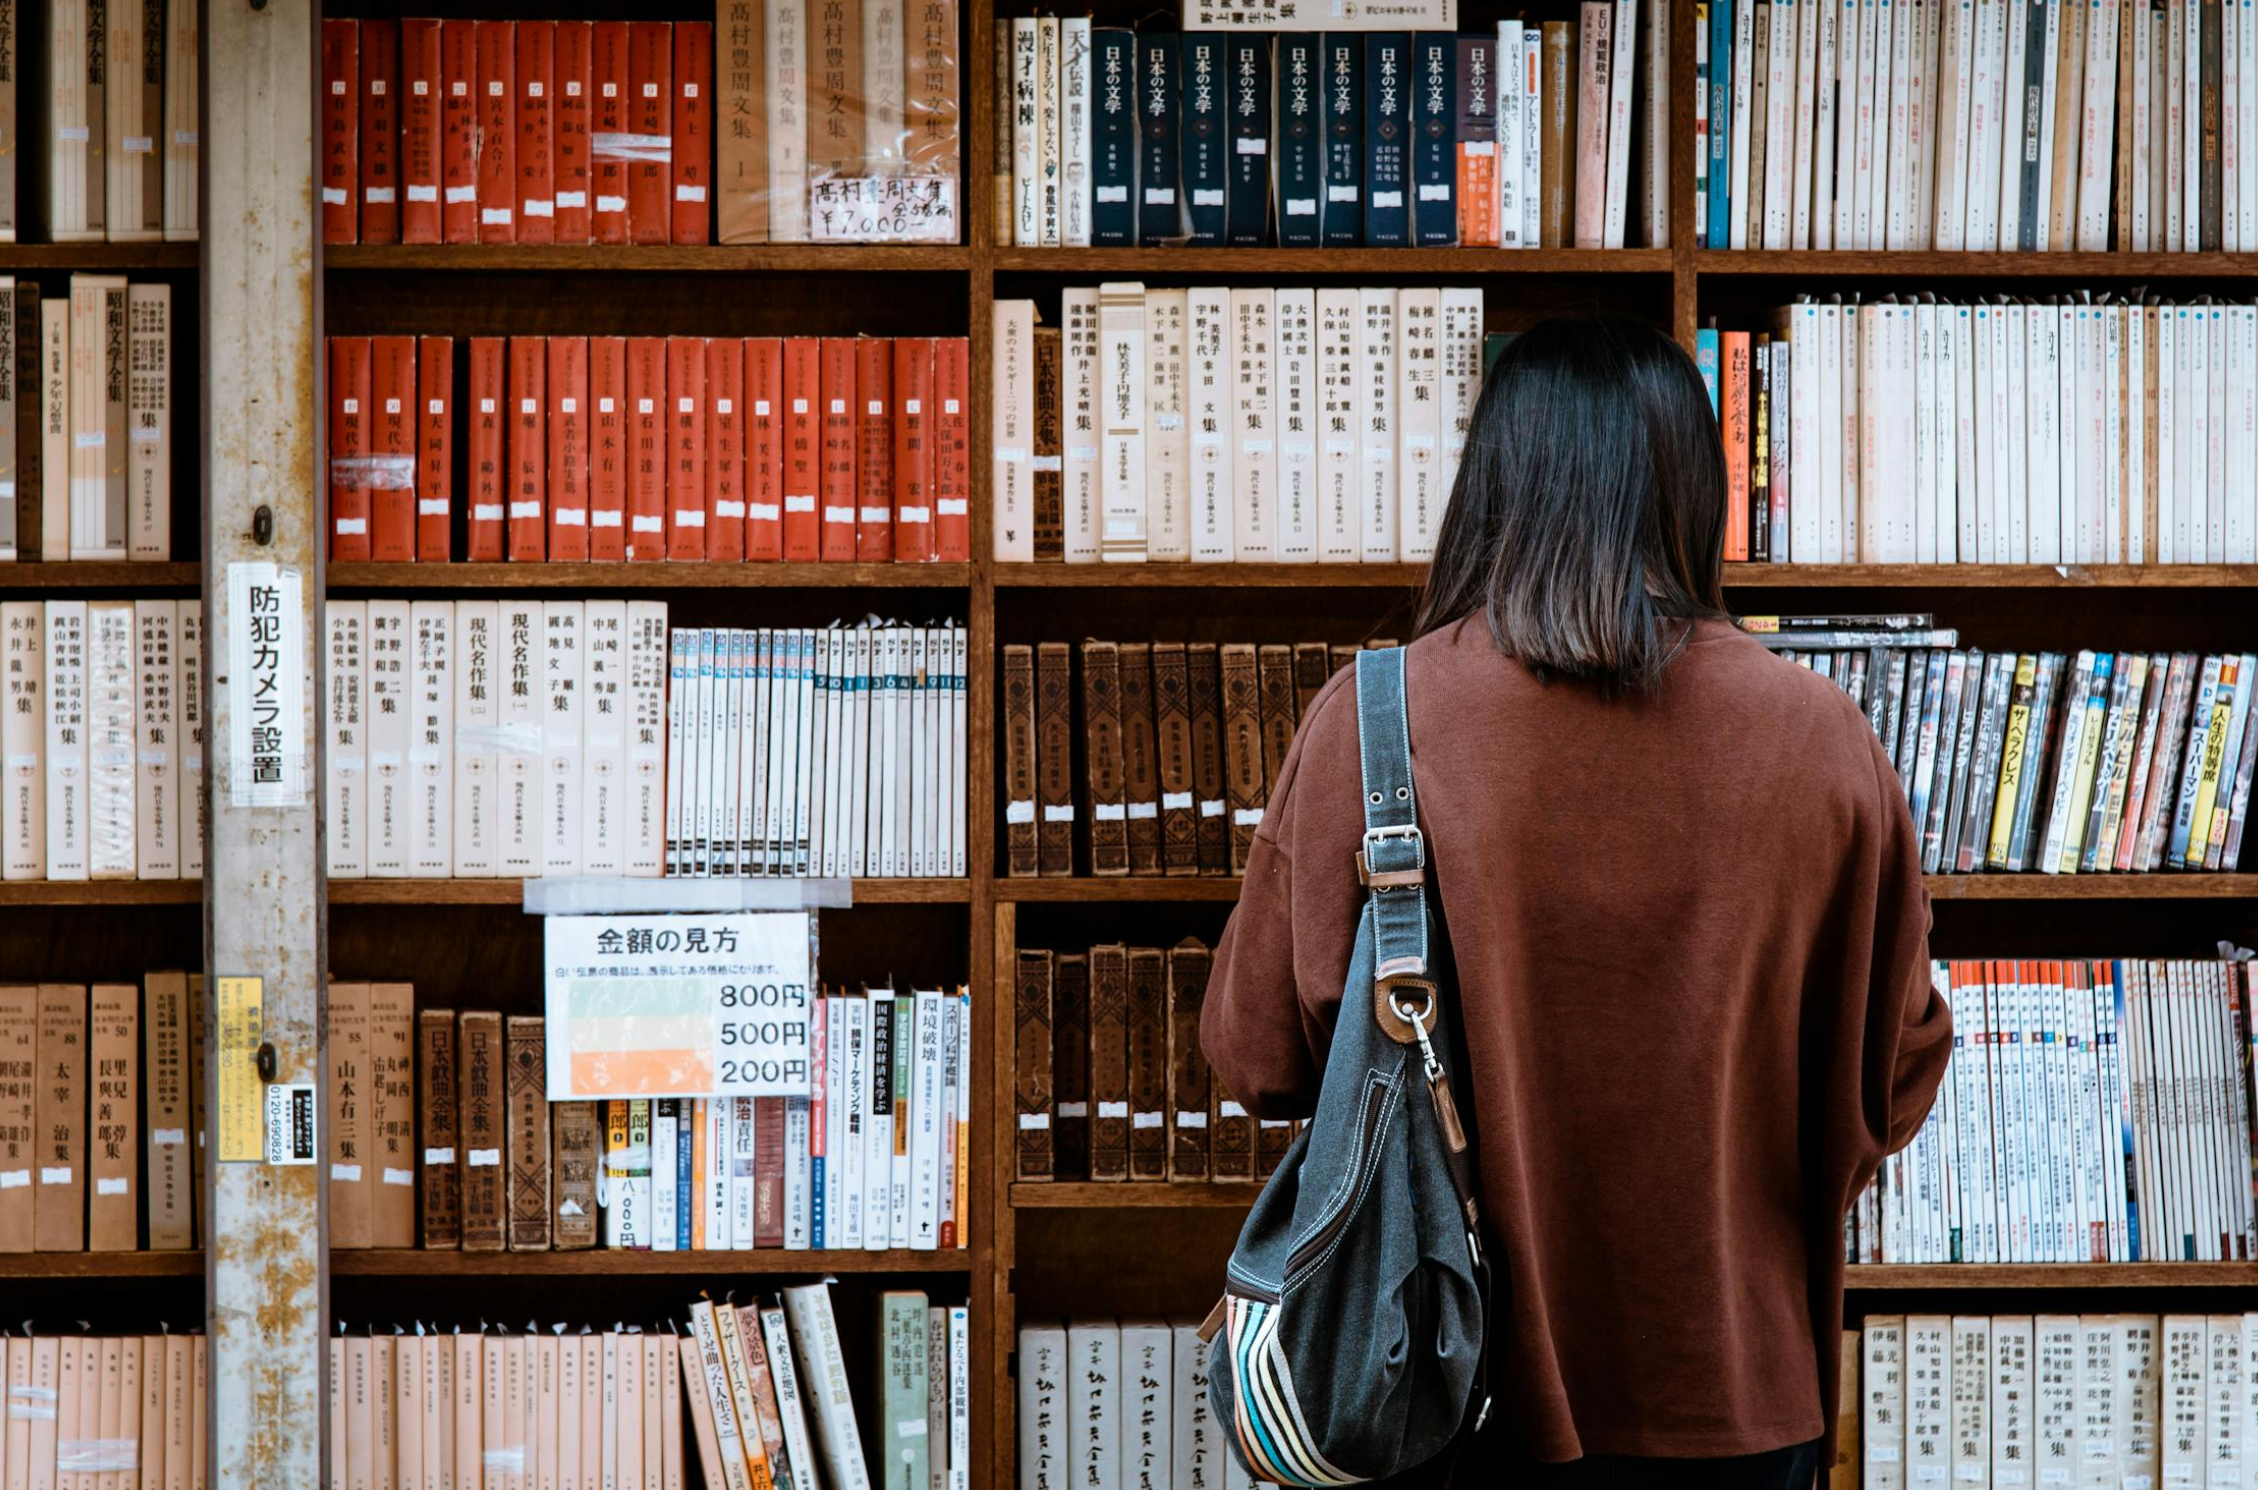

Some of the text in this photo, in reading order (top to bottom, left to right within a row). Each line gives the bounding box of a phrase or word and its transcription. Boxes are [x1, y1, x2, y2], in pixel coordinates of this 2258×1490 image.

[1105, 46, 1122, 114] 日本の文学
[1150, 49, 1165, 116] 日本の文学
[1195, 46, 1212, 113] 日本の文学
[1239, 49, 1256, 116] 日本の文学
[1292, 49, 1308, 115] 日本の文学
[1335, 48, 1350, 115] 日本の文学
[1381, 48, 1397, 115] 日本の文学
[1428, 47, 1444, 115] 日本の文学
[1470, 49, 1486, 115] 日本の文学
[108, 292, 122, 402] 昭和文学全集
[1415, 386, 1430, 402] 集
[1077, 415, 1092, 431] 集
[1203, 418, 1218, 433] 集
[1247, 414, 1262, 430] 集
[1289, 417, 1304, 433] 集
[1332, 417, 1347, 433] 集
[1372, 417, 1387, 432] 集
[470, 618, 487, 700] 現代名作集
[512, 613, 529, 696] 現代名作集
[250, 586, 282, 783] 防犯カメラ設置
[829, 678, 840, 688] 10
[954, 678, 966, 688] 12
[17, 697, 32, 714] 集
[381, 698, 396, 713] 集
[553, 695, 569, 712] 集
[598, 699, 613, 714] 集
[61, 729, 77, 744] 集
[150, 729, 165, 744] 集
[339, 730, 353, 746] 集
[425, 730, 440, 745] 集
[2203, 709, 2226, 782] 人生の特等席
[2003, 709, 2026, 786] ザ・ヘラクレス
[2111, 714, 2139, 780] キル・ビル
[2183, 732, 2205, 799] スーパーマン
[597, 928, 739, 954] 金額の見方
[720, 984, 805, 1008] 800円
[64, 1034, 76, 1045] 88
[116, 1027, 127, 1037] 50
[349, 1033, 361, 1043] 55
[394, 1032, 405, 1042] 91
[721, 1022, 806, 1045] 500円
[922, 998, 938, 1061] 環境破壊
[721, 1060, 807, 1084] 200円
[271, 1087, 281, 1162] 0120-690828
[740, 1309, 764, 1366] 夢の景色
[700, 1312, 731, 1426] どうせ曲った人生さ
[1877, 1409, 1892, 1424] 集
[1920, 1441, 1935, 1456] 集
[2005, 1445, 2021, 1460] 集
[2051, 1442, 2066, 1457] 集
